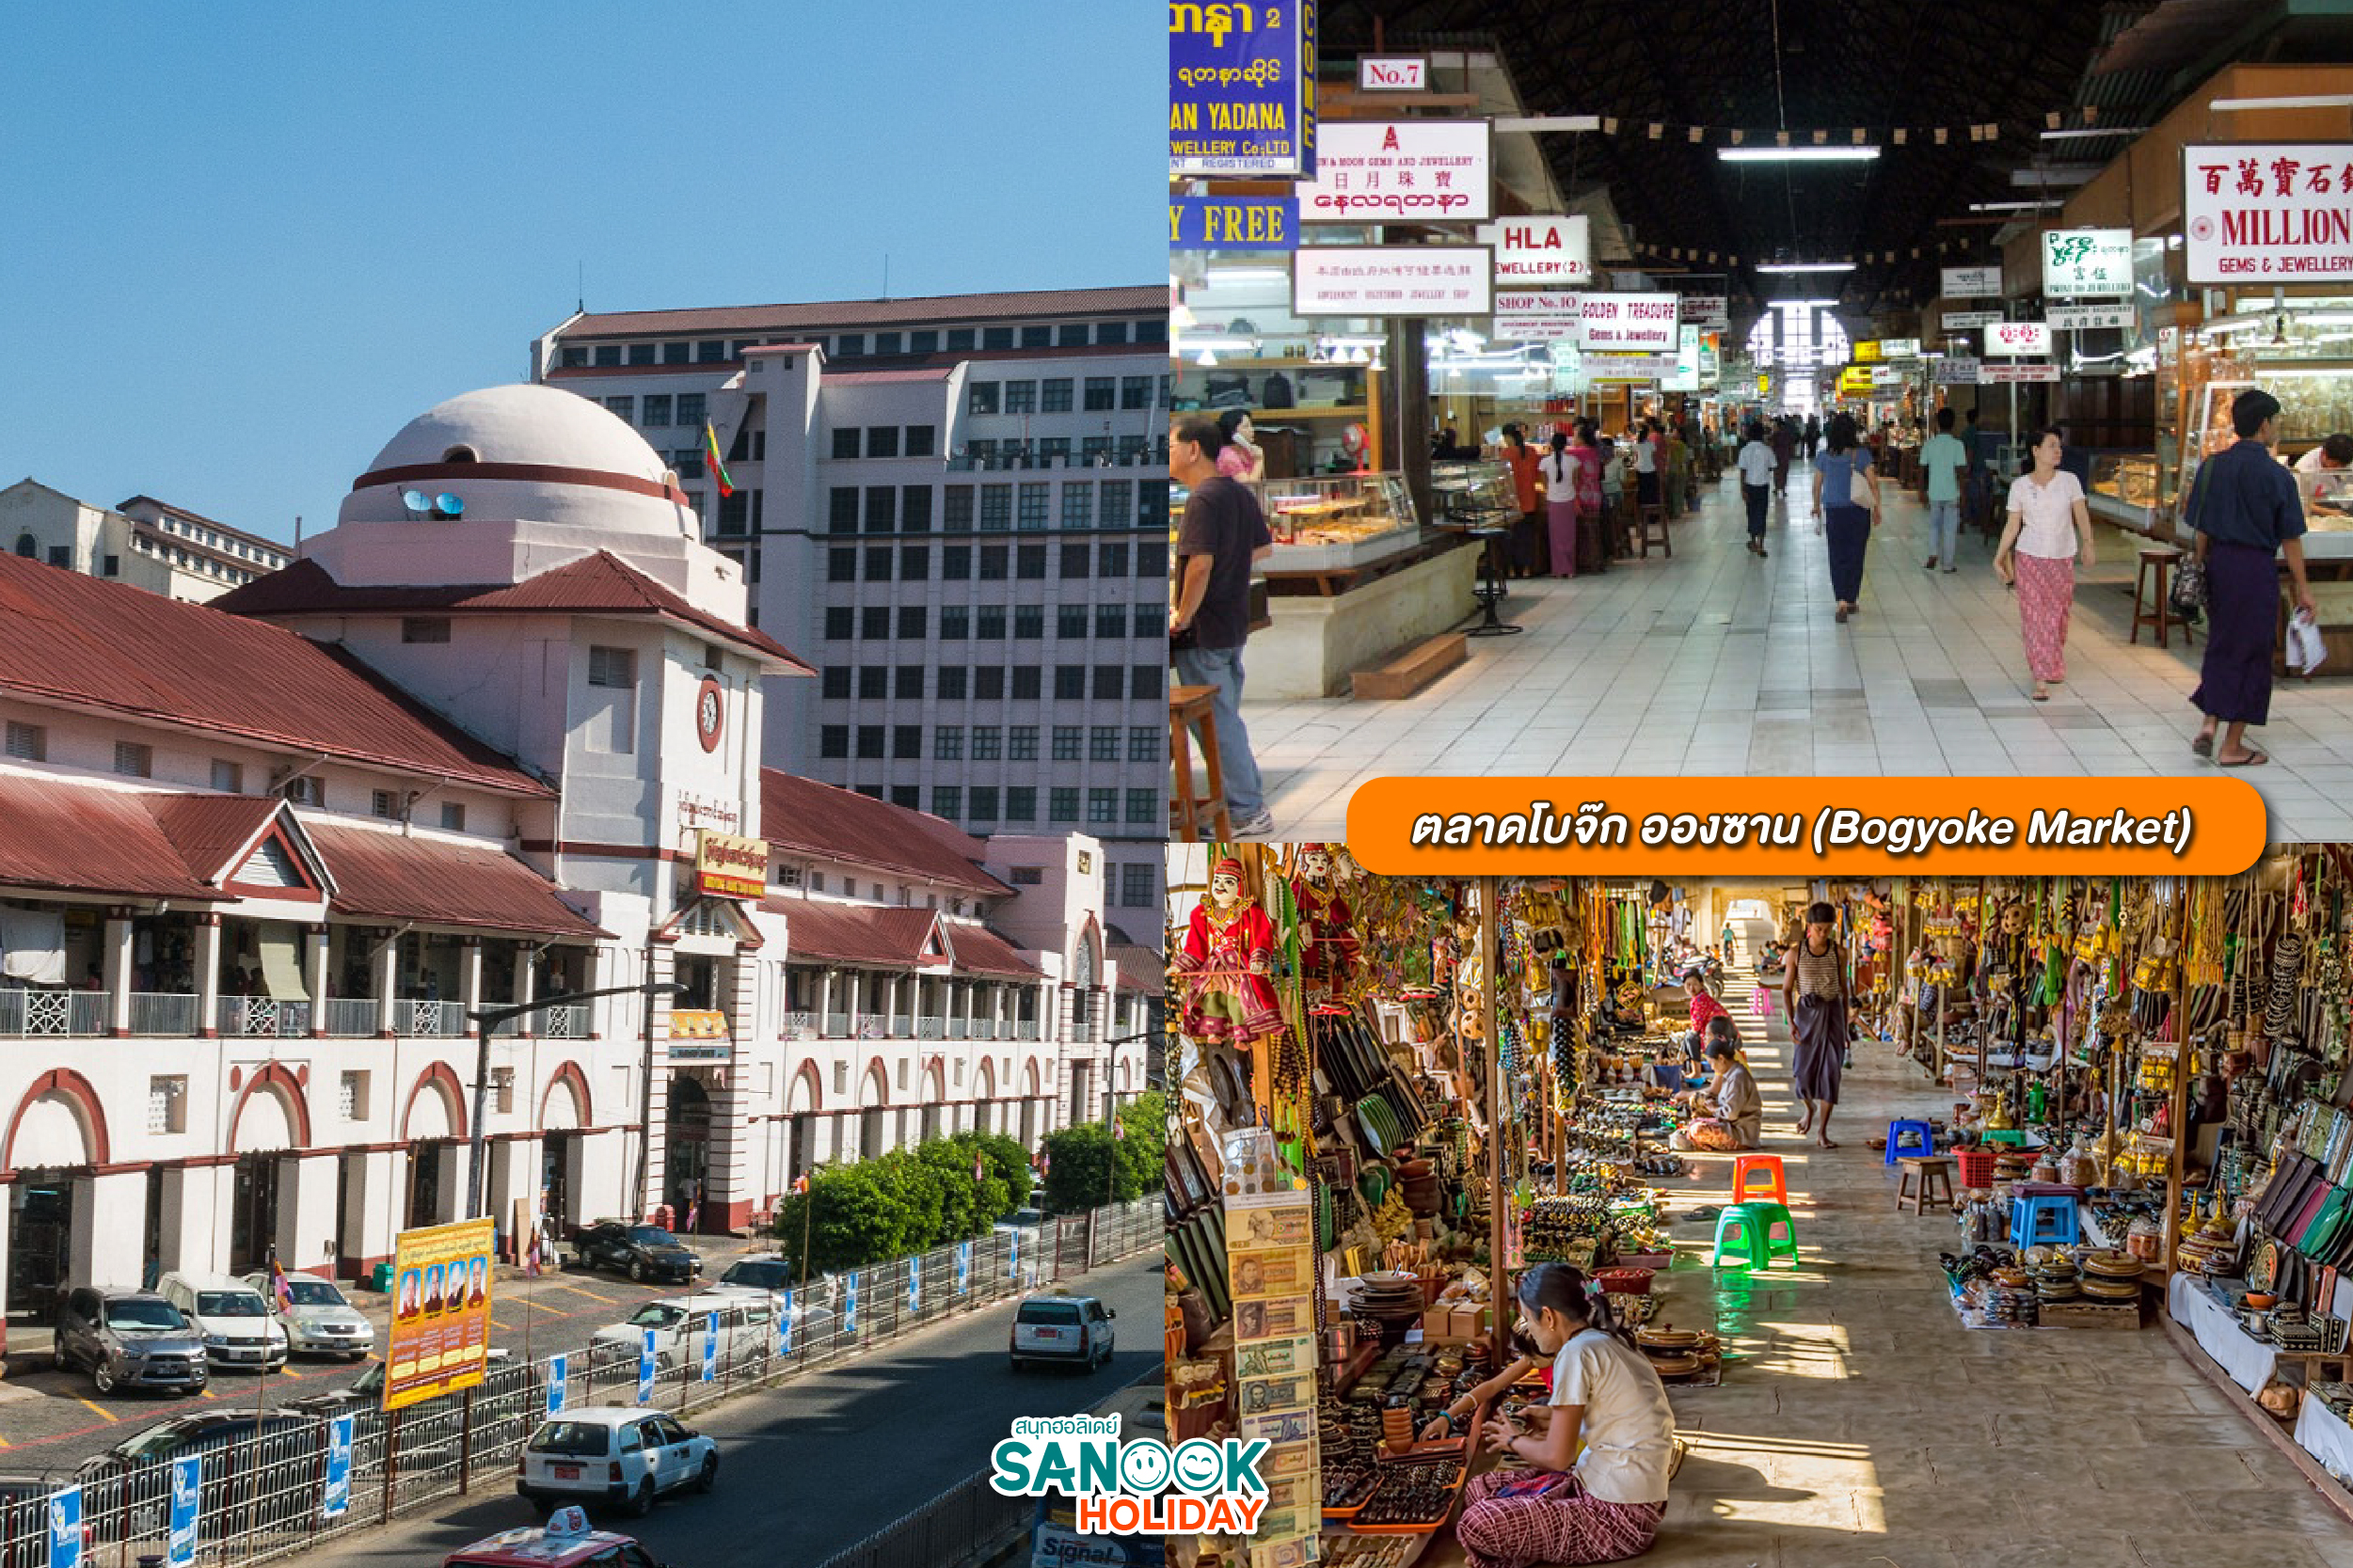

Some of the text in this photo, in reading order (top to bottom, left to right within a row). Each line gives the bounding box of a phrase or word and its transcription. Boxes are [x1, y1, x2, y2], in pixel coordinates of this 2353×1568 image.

[1265, 8, 1280, 28] 2
[1370, 64, 1419, 85] No.7
[1208, 103, 1285, 131] YADANA
[1382, 125, 1399, 150] A
[1201, 158, 1275, 168] REGISTERED
[1339, 157, 1364, 166] MOON
[1368, 157, 1392, 166] GEMS
[1203, 205, 1285, 242] FREE
[2221, 209, 2351, 246] MILLION
[1504, 227, 1562, 250] HLA
[2218, 257, 2256, 274] GEMS
[2262, 257, 2272, 274] &
[1498, 296, 1534, 309] SHOP
[1582, 302, 1618, 319] GOLDEN
[1627, 302, 1675, 320] TREASURE
[1588, 329, 1614, 341] Gems
[1625, 329, 1667, 342] Jewellery
[1041, 1536, 1115, 1564] Signal
